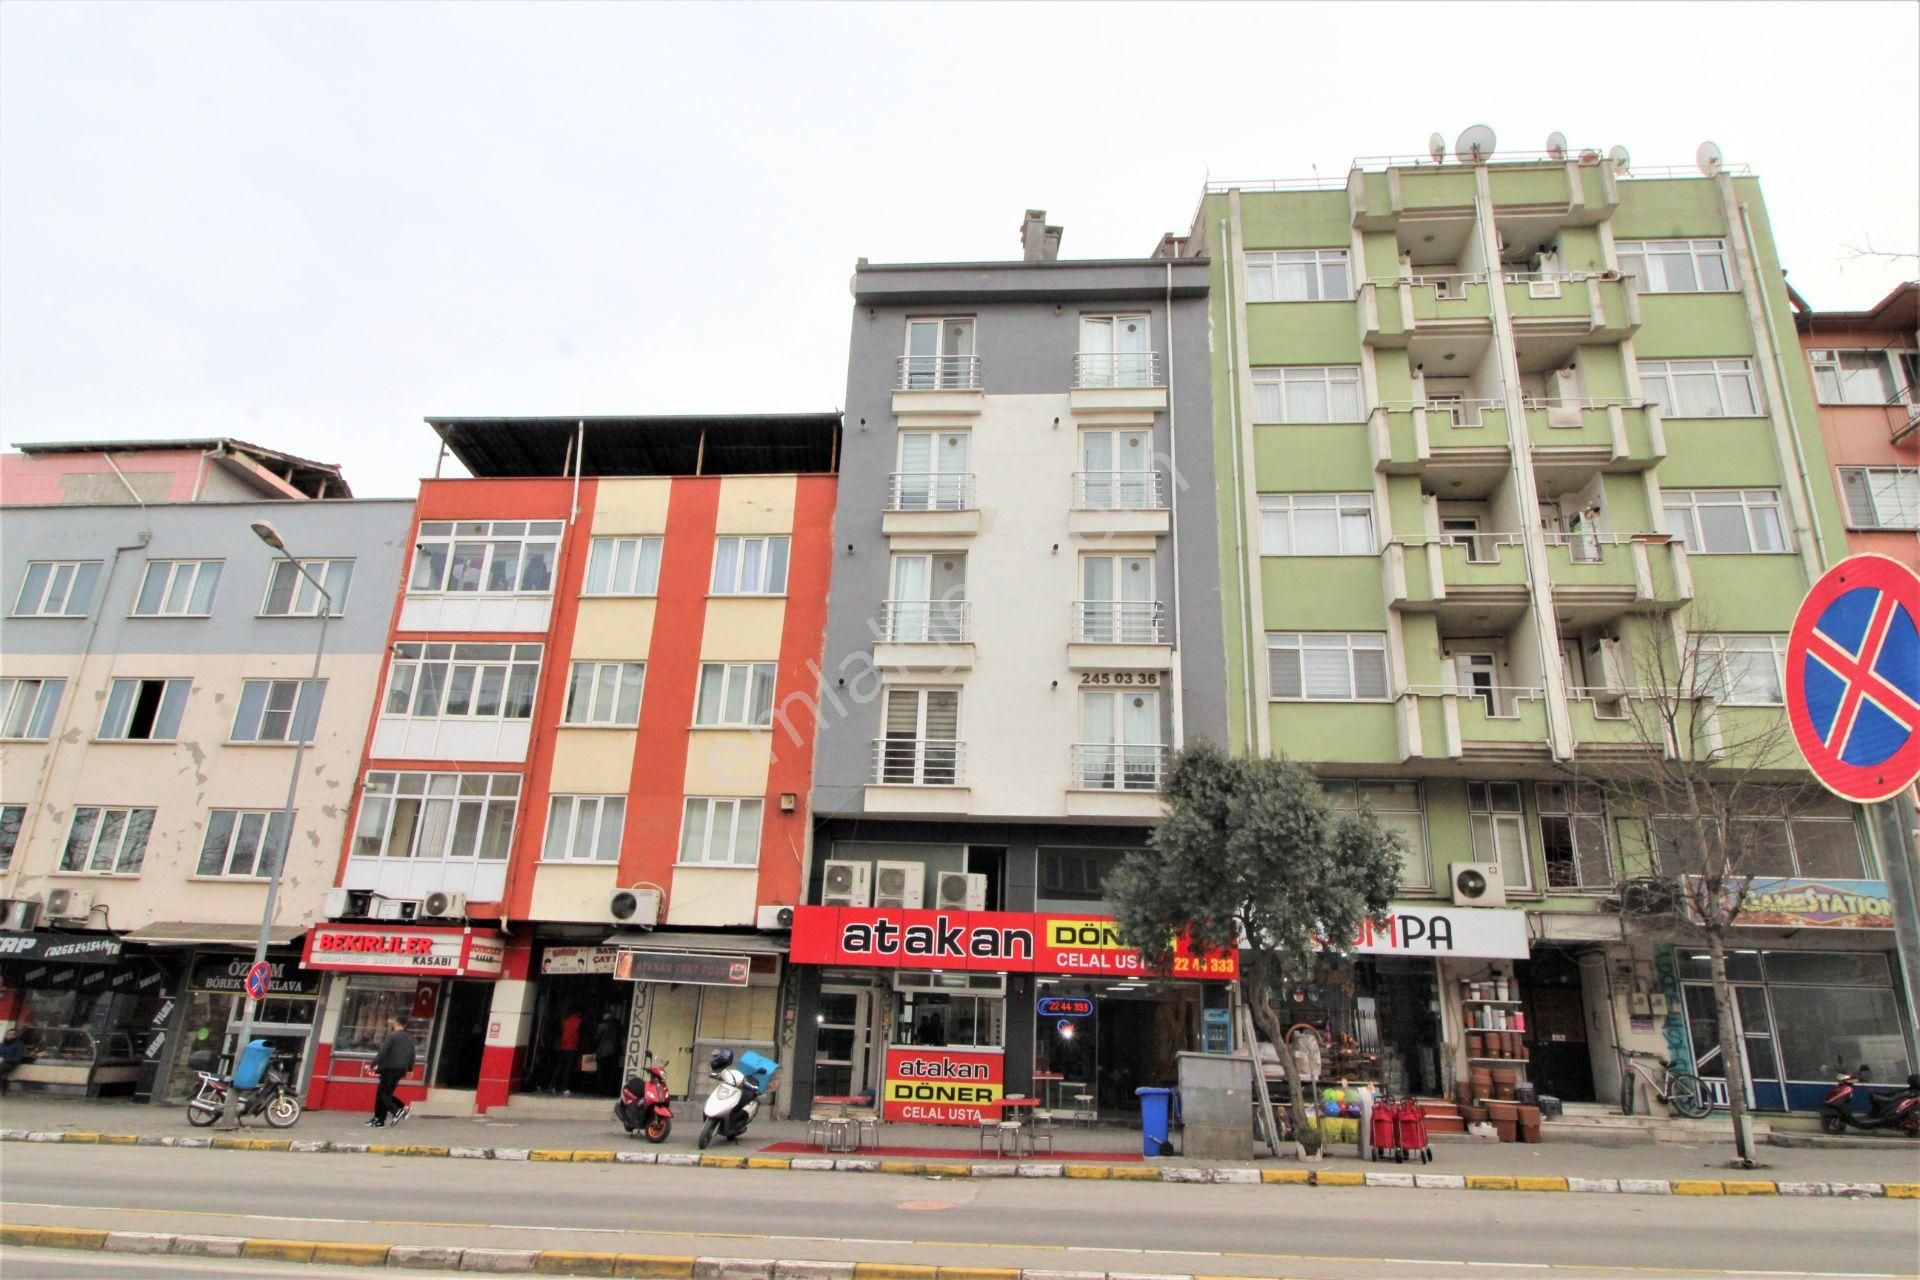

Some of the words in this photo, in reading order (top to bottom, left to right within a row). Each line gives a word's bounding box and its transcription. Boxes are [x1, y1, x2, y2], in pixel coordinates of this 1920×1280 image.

[1081, 673, 1110, 684] 245
[1114, 673, 1133, 684] 03
[1138, 673, 1157, 684] 36
[842, 916, 1034, 959] atakan
[1055, 923, 1125, 946] DÖN
[228, 957, 285, 978] ÖZM
[1056, 952, 1111, 968] CELAL
[1115, 954, 1146, 970] US
[1174, 957, 1189, 971] 22
[1211, 958, 1234, 973] 333
[205, 977, 241, 989] BÖREK
[268, 980, 302, 991] KLAVA
[1049, 1001, 1060, 1011] 22
[1061, 1002, 1072, 1011] 44
[1074, 1003, 1089, 1012] 333
[899, 1057, 990, 1079] atakan
[894, 1082, 993, 1102] DÖNER
[902, 1106, 945, 1119] CELAL
[949, 1108, 982, 1121] USTA
